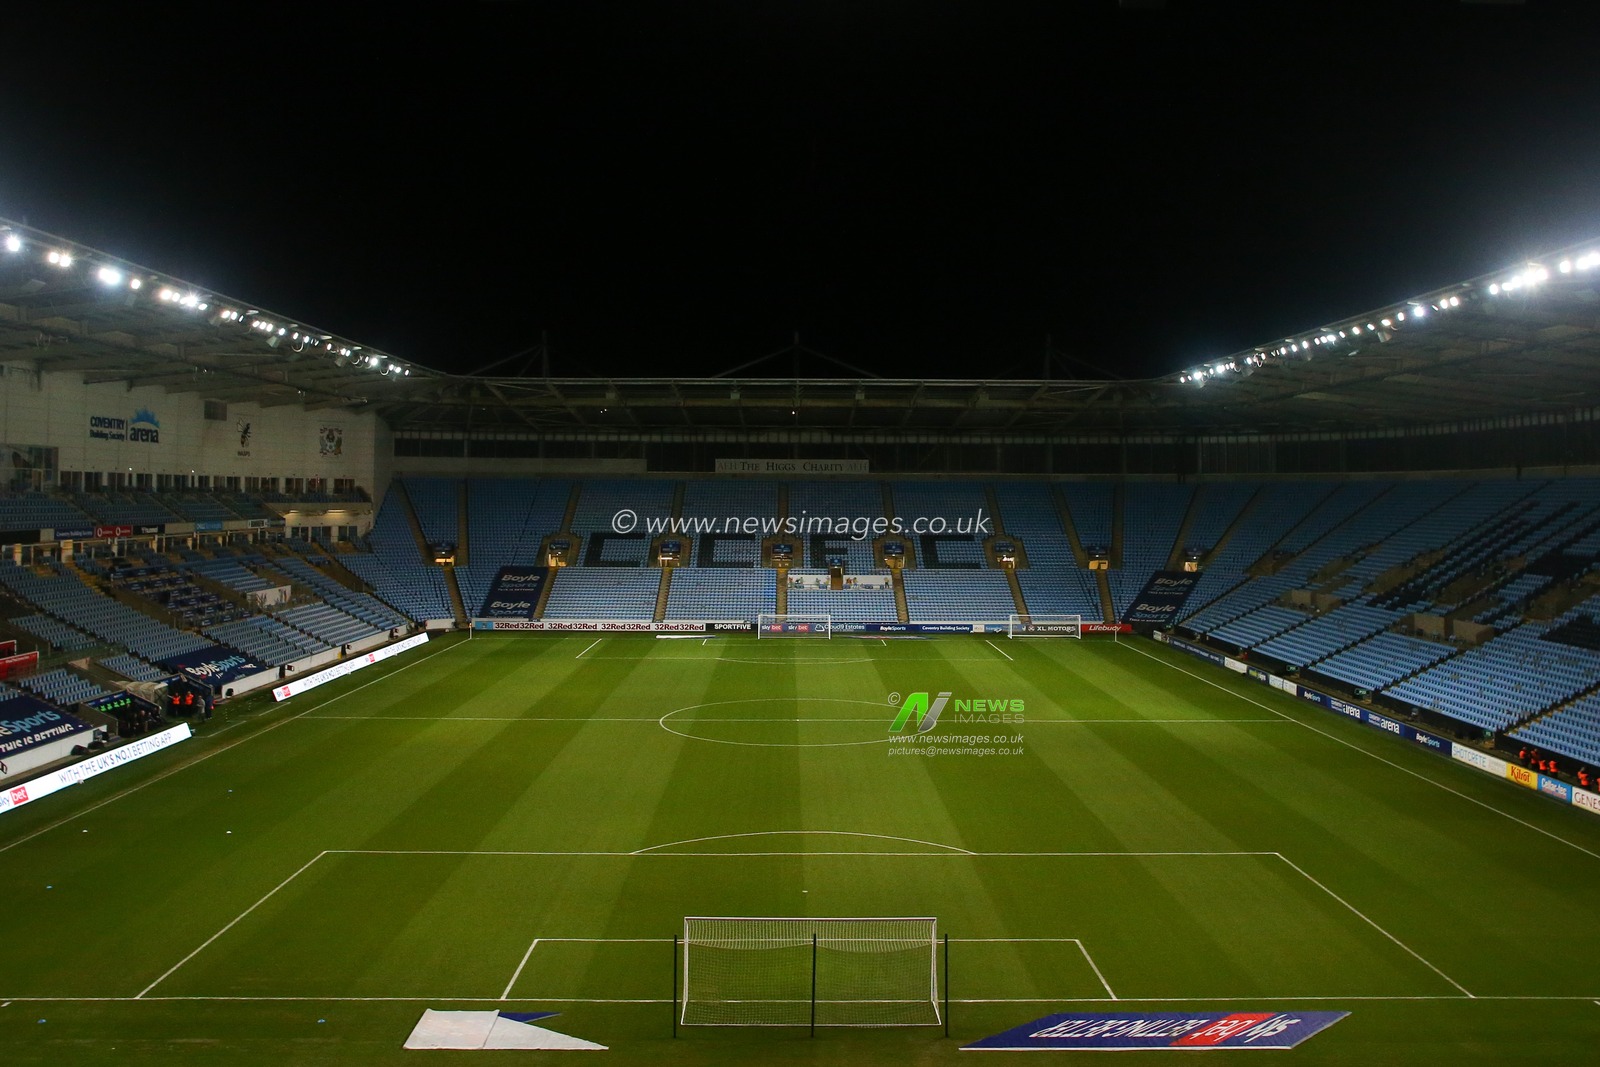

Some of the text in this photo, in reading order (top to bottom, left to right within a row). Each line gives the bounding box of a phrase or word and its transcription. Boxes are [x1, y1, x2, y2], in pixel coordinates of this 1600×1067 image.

[90, 415, 125, 430] COVENTRY
[129, 427, 159, 443] arena
[766, 461, 796, 471] HIGGS
[803, 461, 844, 471] CHARITY
[501, 574, 541, 582] Boyle
[1154, 577, 1193, 586] Boyle
[490, 601, 531, 609] Boyle
[1136, 603, 1176, 613] Boyle
[1380, 718, 1400, 734] arena
[11, 788, 27, 802] bet
[57, 769, 81, 784] WITH
[80, 760, 96, 775] THE
[133, 737, 161, 756] BETTING
[1190, 1019, 1256, 1042] bet
[1236, 1013, 1302, 1043] sky
